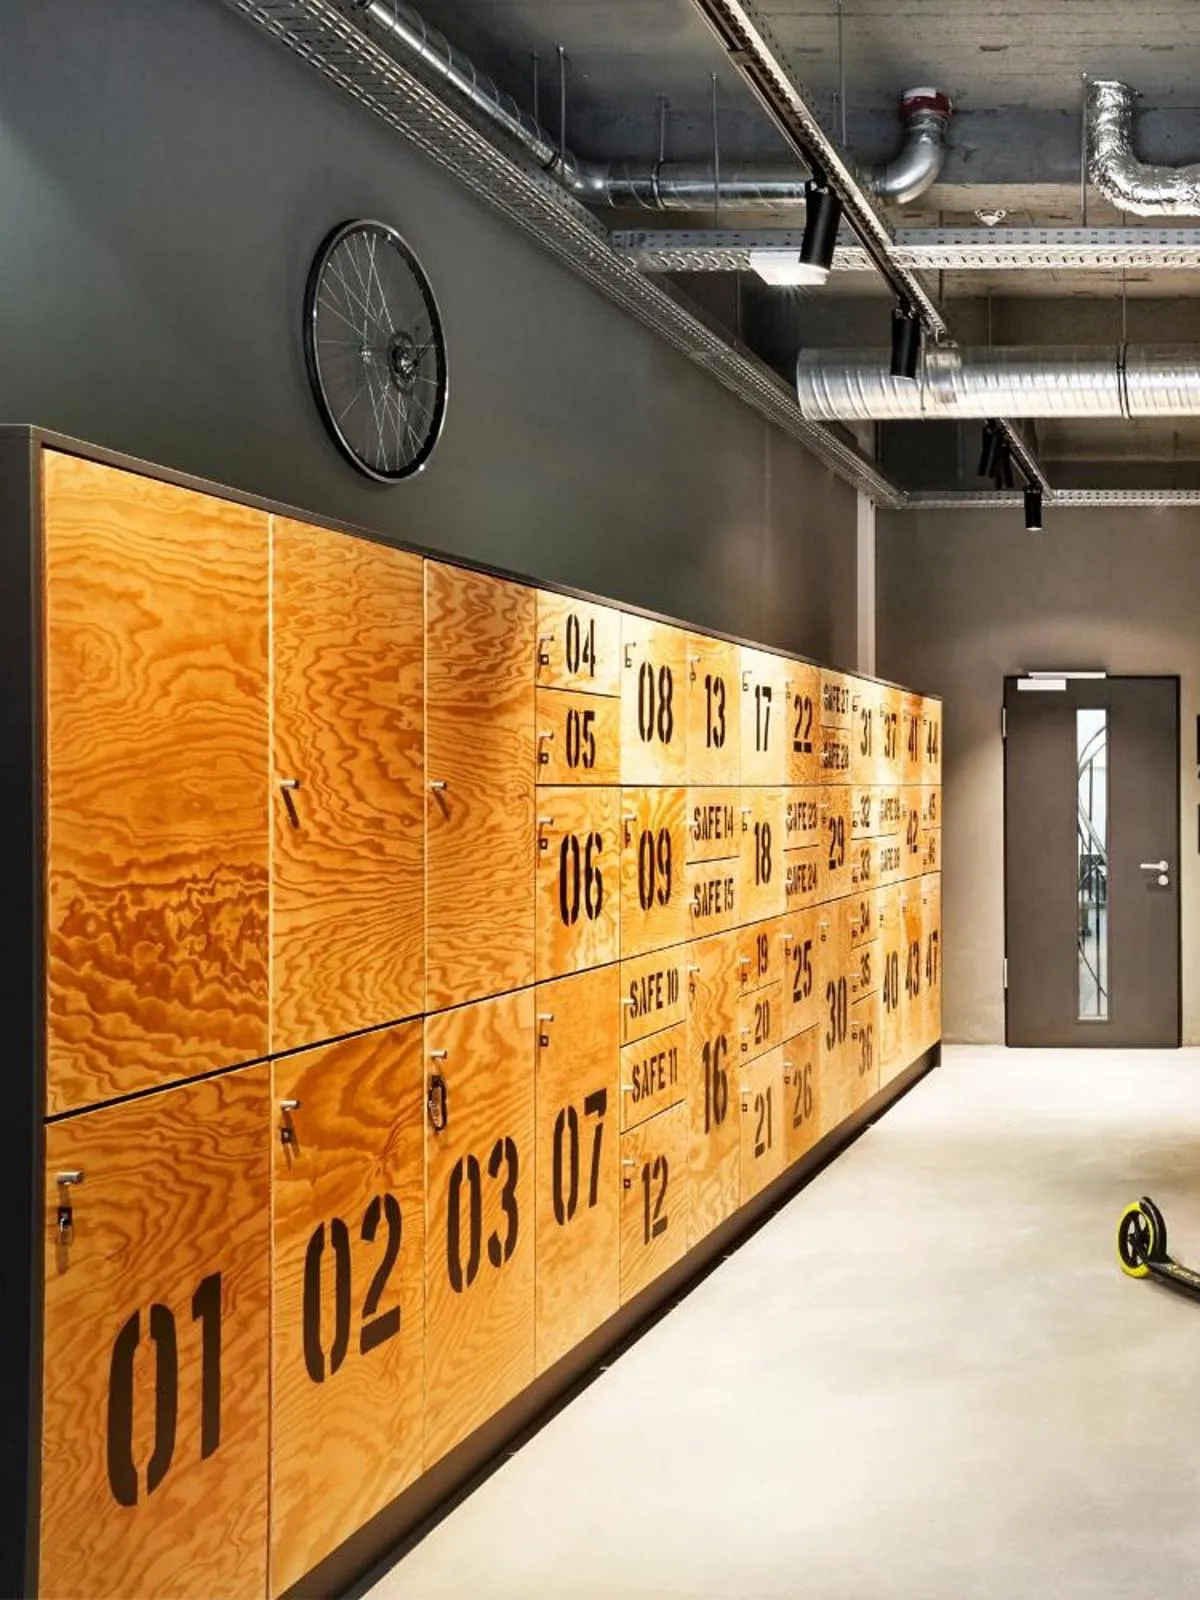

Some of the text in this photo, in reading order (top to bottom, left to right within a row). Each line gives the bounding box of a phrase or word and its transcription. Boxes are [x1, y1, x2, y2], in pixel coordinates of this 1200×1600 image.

[565, 614, 596, 677] 04
[638, 662, 673, 744] 08
[705, 674, 726, 749] 13
[755, 684, 772, 752] 17
[793, 694, 813, 753] 22
[860, 708, 872, 757] 31
[565, 709, 596, 769] 05
[884, 713, 897, 760] 37
[908, 716, 918, 763] 41
[926, 720, 939, 764] 44
[694, 805, 734, 841] SAFE 14
[860, 796, 871, 828] 32
[906, 809, 919, 854] 42
[639, 827, 672, 911] 09
[755, 822, 771, 886] 18
[828, 816, 844, 870] 29
[560, 831, 603, 927] 06
[694, 878, 734, 918] SAFE 15
[860, 900, 870, 934] 34
[756, 934, 768, 977] 19
[793, 940, 812, 1003] 25
[883, 950, 899, 1014] 40
[905, 941, 920, 1001] 43
[926, 929, 938, 987] 47
[630, 968, 679, 1019] SAFE 10
[755, 1000, 770, 1045] 20
[826, 976, 847, 1051] 30
[631, 1047, 678, 1103] SAFE 11
[858, 1022, 873, 1077] 36
[702, 1034, 728, 1135] 16
[793, 1062, 812, 1129] 26
[755, 1086, 772, 1159] 21
[553, 1087, 607, 1226] 07
[446, 1135, 519, 1293] 03
[641, 1154, 668, 1245] 12
[303, 1192, 402, 1383] 02
[107, 1271, 222, 1507] 01
